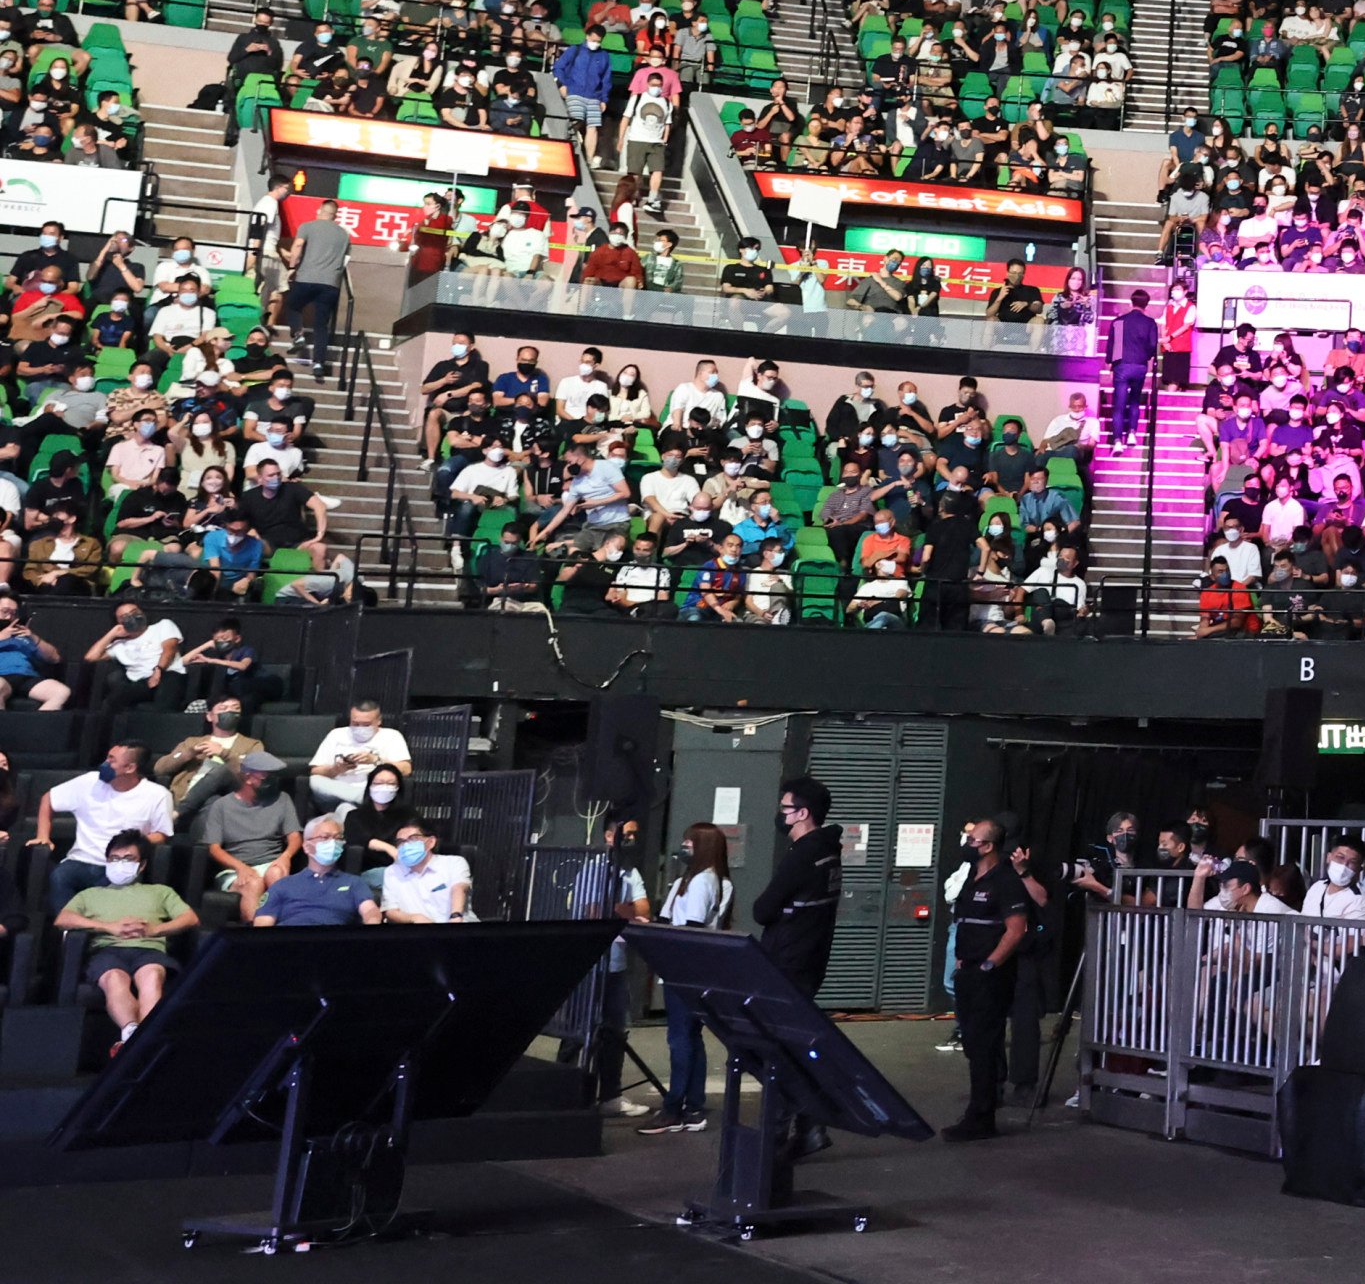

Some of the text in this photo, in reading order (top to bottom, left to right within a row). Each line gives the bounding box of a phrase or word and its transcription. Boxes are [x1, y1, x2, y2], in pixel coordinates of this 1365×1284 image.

[306, 118, 542, 170] 東亞行
[772, 178, 1067, 217] Bk of East Asia
[872, 233, 921, 252] EXIT
[834, 259, 993, 294] 東行
[1300, 657, 1315, 682] B
